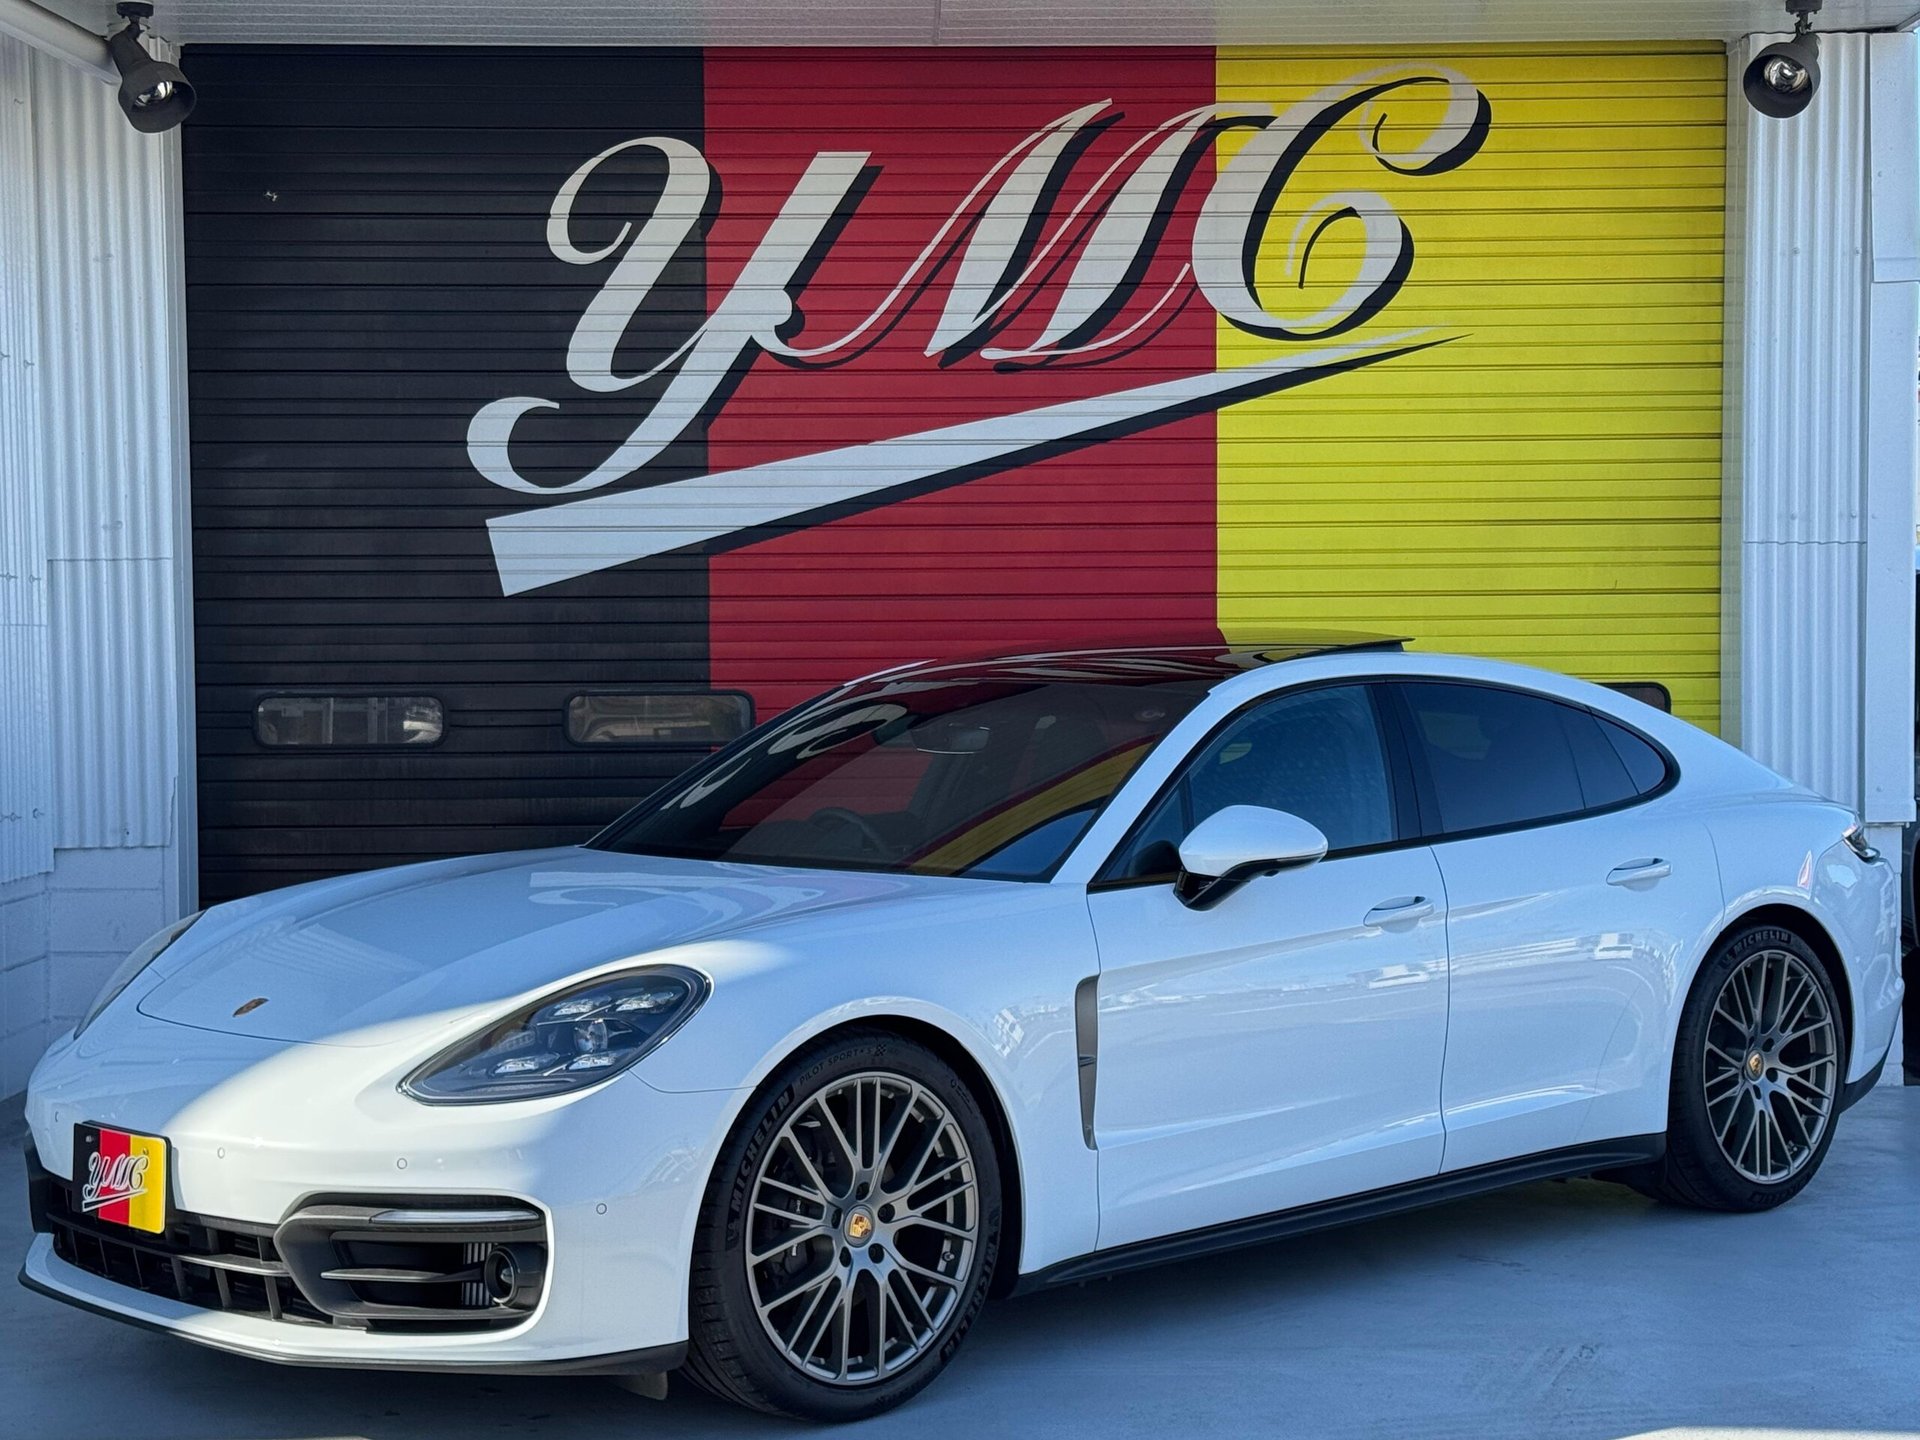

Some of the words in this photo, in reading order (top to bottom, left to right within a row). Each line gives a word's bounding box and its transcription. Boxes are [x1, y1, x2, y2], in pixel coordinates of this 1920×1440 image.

[466, 62, 1491, 496] YMC
[1733, 930, 1789, 954] MICHELIN
[799, 1062, 824, 1086] PILOT
[828, 1049, 858, 1066] SPORT
[731, 1090, 790, 1212] MICHELIN
